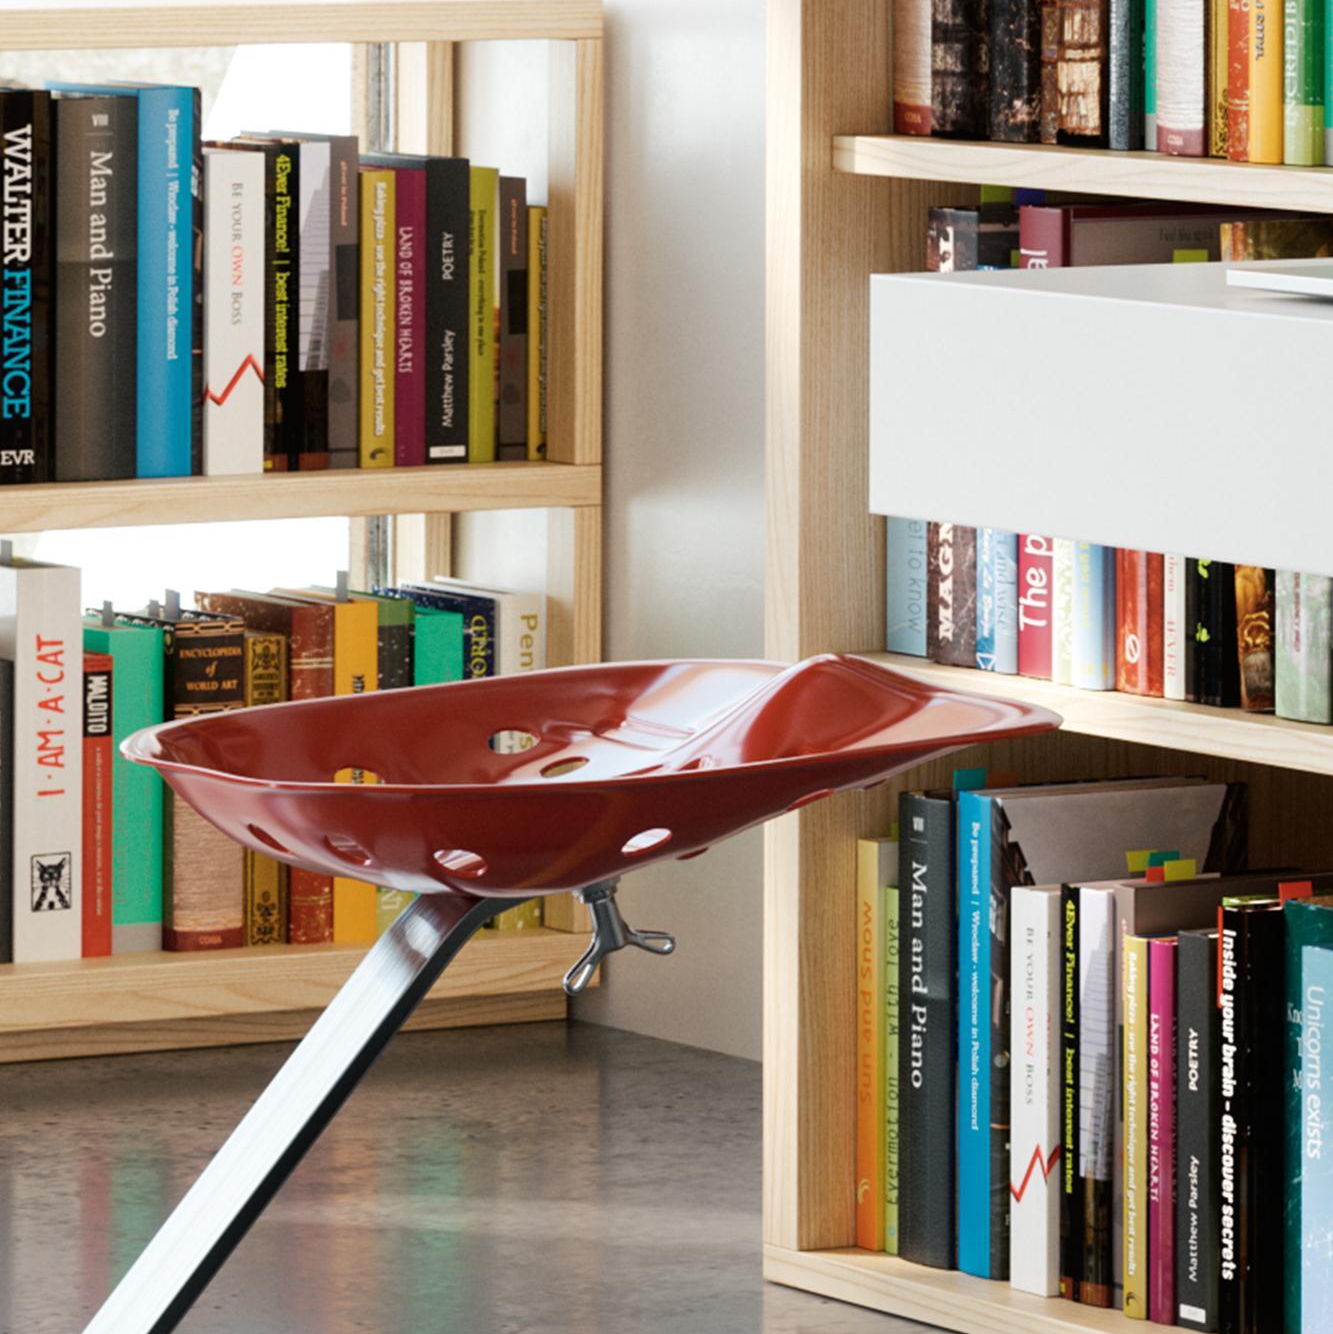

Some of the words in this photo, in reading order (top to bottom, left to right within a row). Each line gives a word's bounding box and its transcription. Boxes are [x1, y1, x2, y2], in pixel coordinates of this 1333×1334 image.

[2, 123, 33, 265] WALTER
[89, 150, 114, 207] Man
[89, 213, 114, 261] and
[442, 231, 455, 281] POETRY
[89, 267, 114, 338] Piano
[2, 267, 33, 420] FINANCE
[1, 449, 35, 466] EVR
[1018, 566, 1049, 632] The
[205, 660, 218, 678] of
[912, 861, 928, 929] Man
[912, 937, 928, 995] and
[912, 1003, 928, 1089] Piano
[1188, 1028, 1200, 1091] POETRY
[1306, 986, 1325, 1090] Unicorns
[1306, 1093, 1325, 1160] exists
[1188, 1155, 1200, 1208] Parsley
[1188, 1213, 1200, 1282] Matthew
